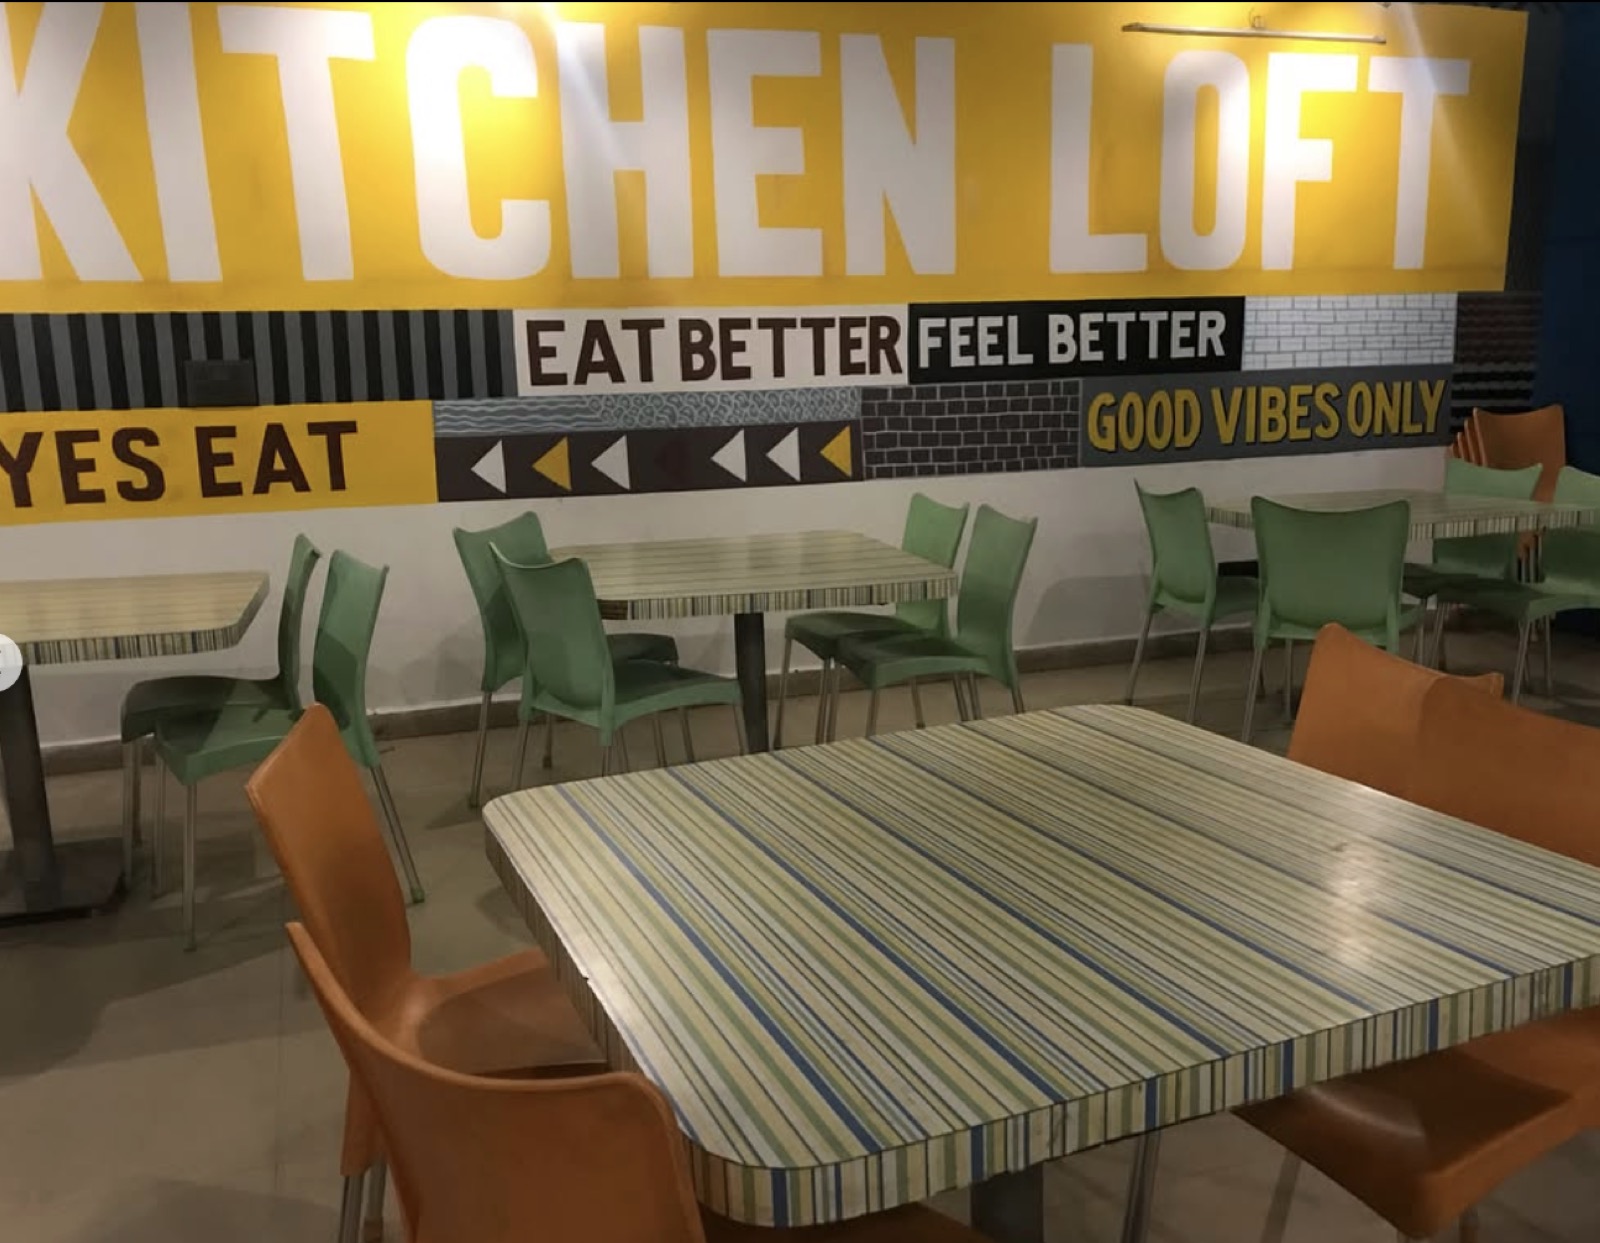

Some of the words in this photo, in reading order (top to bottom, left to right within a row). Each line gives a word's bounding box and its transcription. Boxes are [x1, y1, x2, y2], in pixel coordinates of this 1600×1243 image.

[0, 3, 956, 283] KITCHEN
[1048, 43, 1471, 274] LOFT
[526, 319, 664, 386] EAT
[679, 316, 902, 381] BETTER
[918, 315, 1034, 369] FEEL
[1048, 311, 1226, 364] BETTER
[1088, 390, 1202, 453] GOOD
[1212, 383, 1340, 445] VIBES
[1346, 379, 1446, 436] ONLY
[0, 427, 166, 508] YES
[195, 420, 358, 498] EAT
